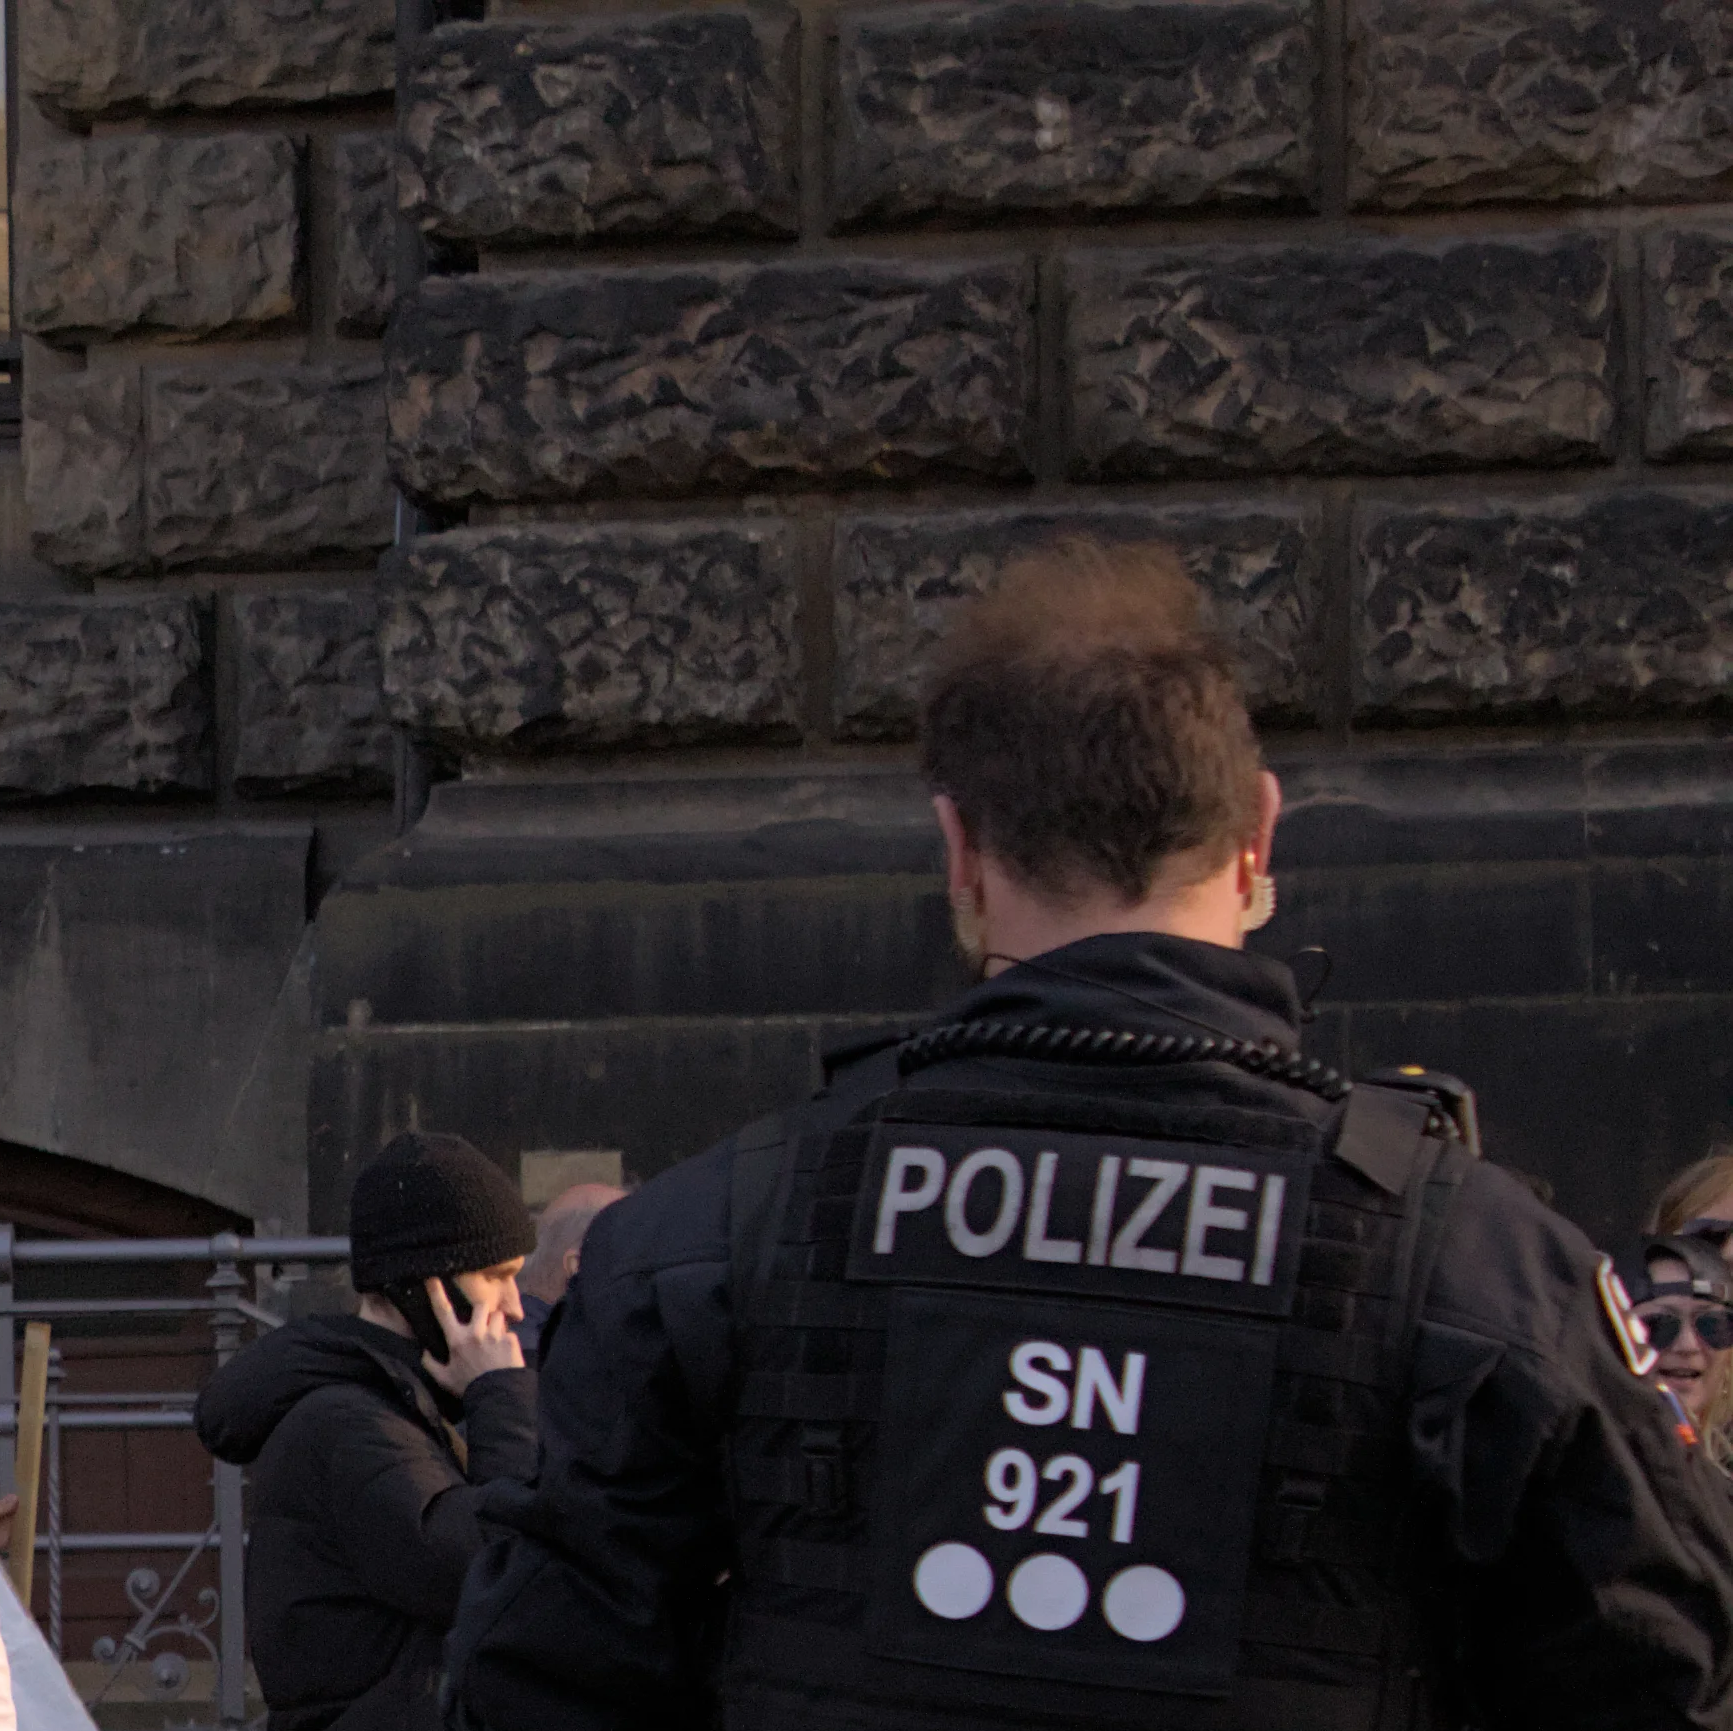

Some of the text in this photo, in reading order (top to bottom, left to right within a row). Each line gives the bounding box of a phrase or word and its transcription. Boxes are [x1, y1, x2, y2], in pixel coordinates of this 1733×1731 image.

[873, 1146, 1286, 1286] POLIZEI
[1002, 1341, 1146, 1435] SN
[982, 1447, 1141, 1544] 921
